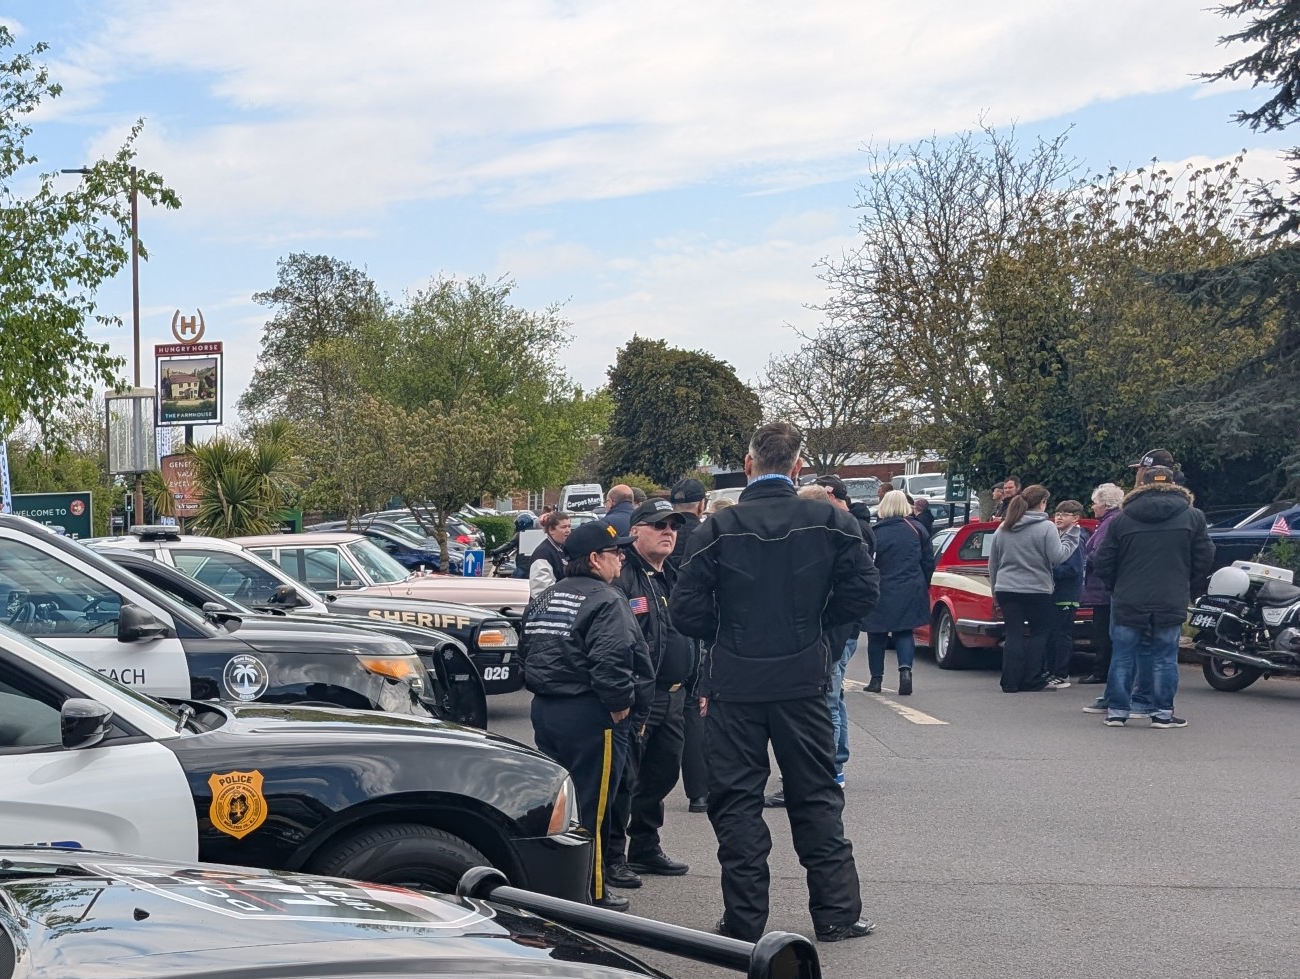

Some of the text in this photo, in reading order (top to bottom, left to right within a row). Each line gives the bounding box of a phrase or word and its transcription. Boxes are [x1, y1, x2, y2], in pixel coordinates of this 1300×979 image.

[158, 344, 218, 353] HUNGRY HORSE
[13, 508, 67, 517] WELCOME TO
[368, 609, 471, 630] SHERIFF
[1194, 613, 1213, 628] 911
[484, 666, 510, 681] 026
[219, 775, 253, 787] POLICE
